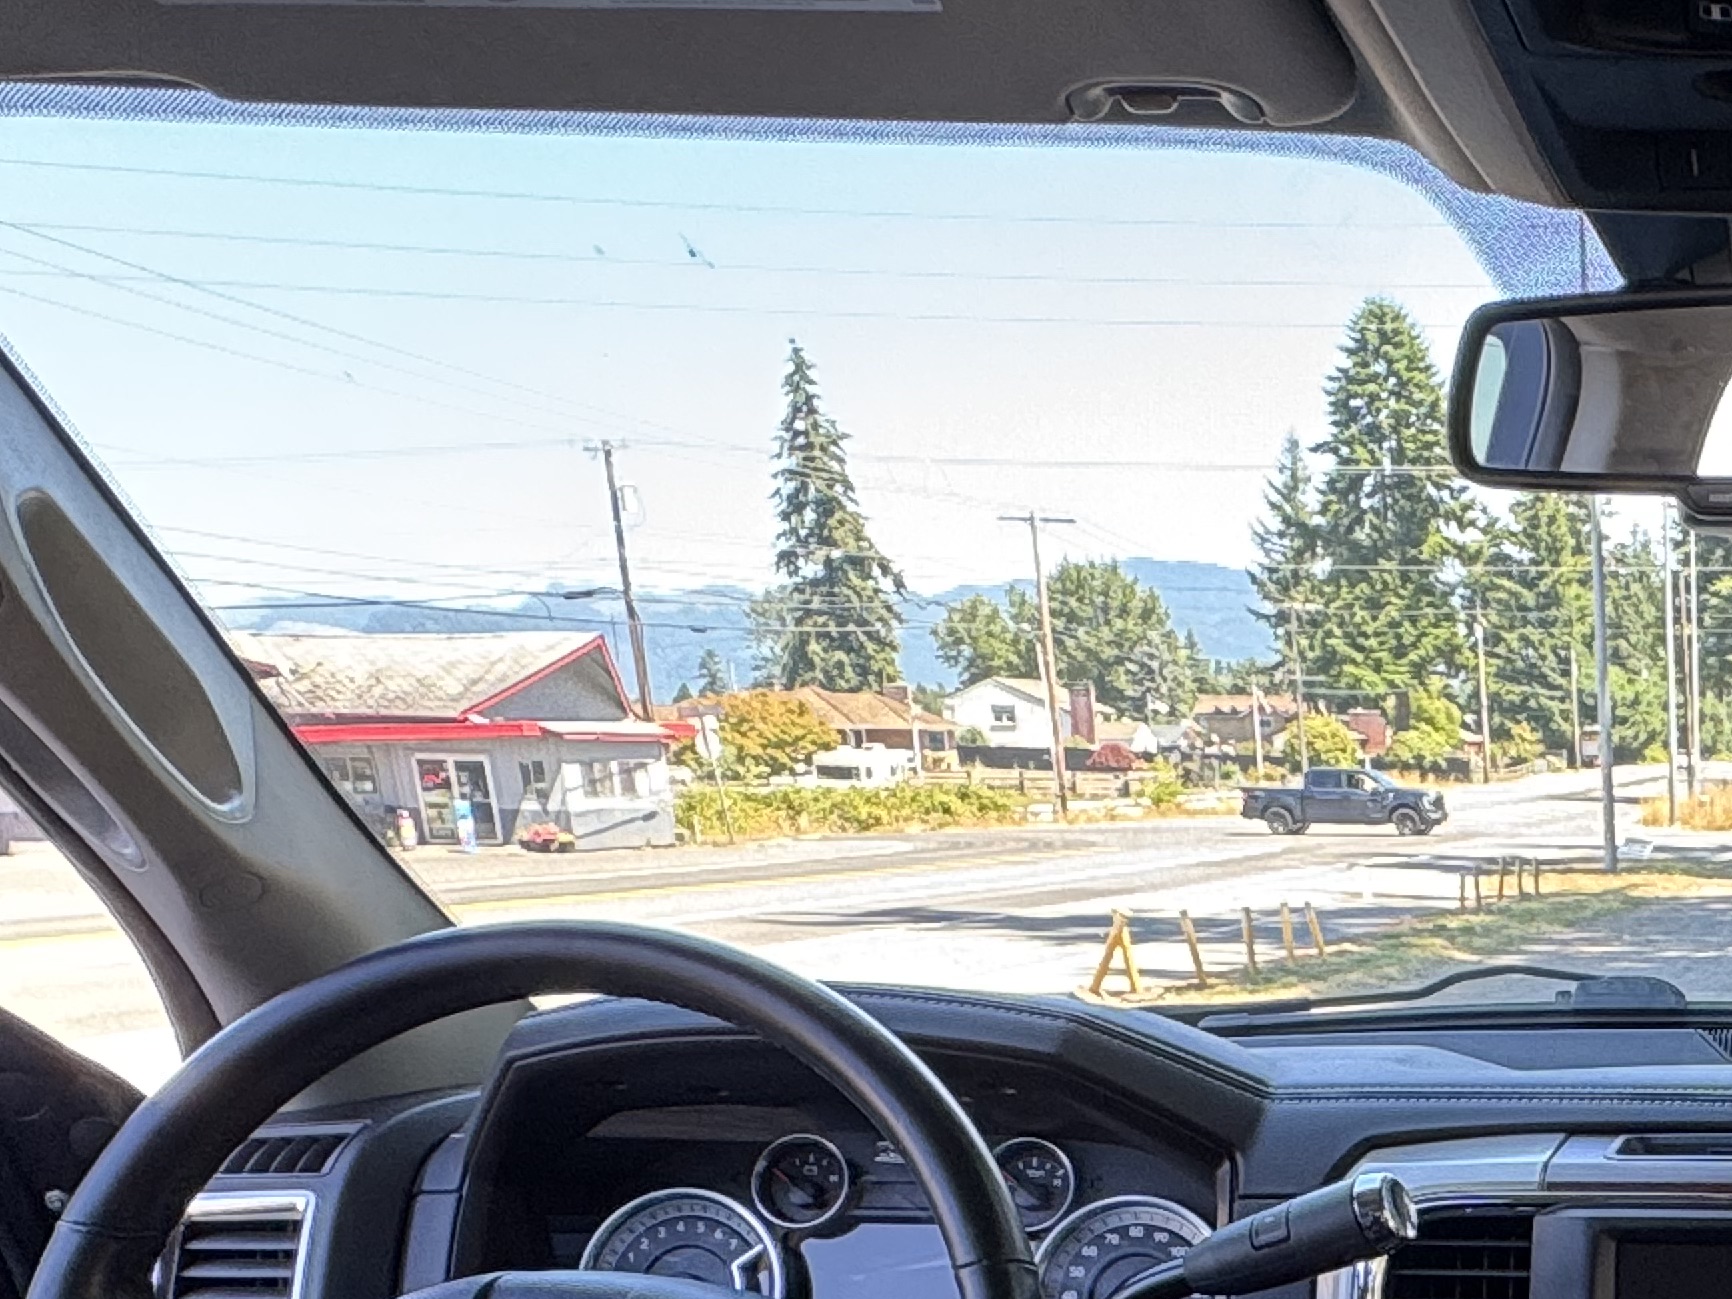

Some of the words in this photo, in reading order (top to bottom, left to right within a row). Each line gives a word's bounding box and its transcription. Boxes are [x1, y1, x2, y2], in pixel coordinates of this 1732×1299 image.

[657, 1226, 666, 1239] 3
[676, 1220, 686, 1233] 4
[697, 1220, 706, 1234] 5
[714, 1226, 724, 1240] 6
[1128, 1225, 1144, 1238] 80
[640, 1237, 650, 1250] 2
[728, 1238, 738, 1250] 7
[1103, 1232, 1120, 1246] 70
[1153, 1232, 1169, 1244] 90
[628, 1251, 635, 1263] 1
[1080, 1245, 1098, 1257] 60
[1068, 1266, 1086, 1278] 50
